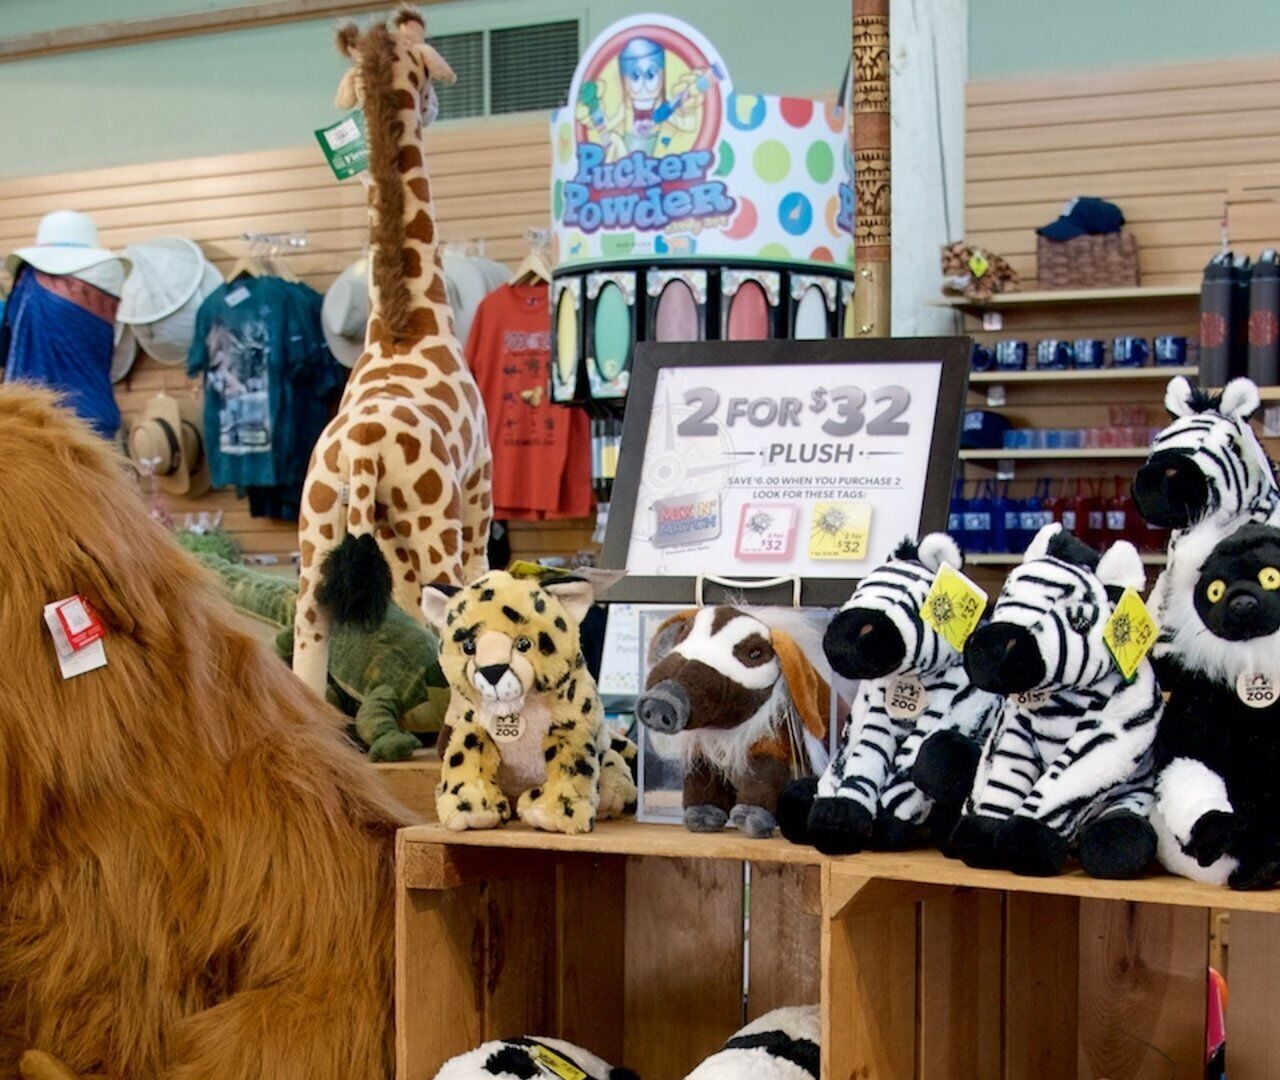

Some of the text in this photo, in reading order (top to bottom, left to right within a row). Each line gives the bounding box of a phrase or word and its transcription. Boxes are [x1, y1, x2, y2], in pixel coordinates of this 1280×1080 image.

[577, 142, 715, 190] Pucker
[677, 385, 912, 437] 2 FOR $32
[769, 443, 854, 464] PLUSH
[728, 477, 752, 486] SAVE
[781, 476, 813, 486] WHEN
[815, 476, 837, 486] YOU
[838, 476, 890, 486] PURCHASE
[891, 476, 901, 486] 2
[752, 490, 778, 499] LOOK
[780, 490, 803, 499] FOR
[804, 490, 835, 499] THESE
[660, 504, 694, 523] MIX
[660, 516, 717, 537] MATCH
[761, 539, 782, 551] $32
[837, 540, 861, 553] $32
[961, 598, 979, 620] $32
[1136, 624, 1151, 646] $32
[1247, 691, 1273, 701] ZOO
[891, 699, 916, 711] ZOO
[496, 729, 519, 737] ZOO
